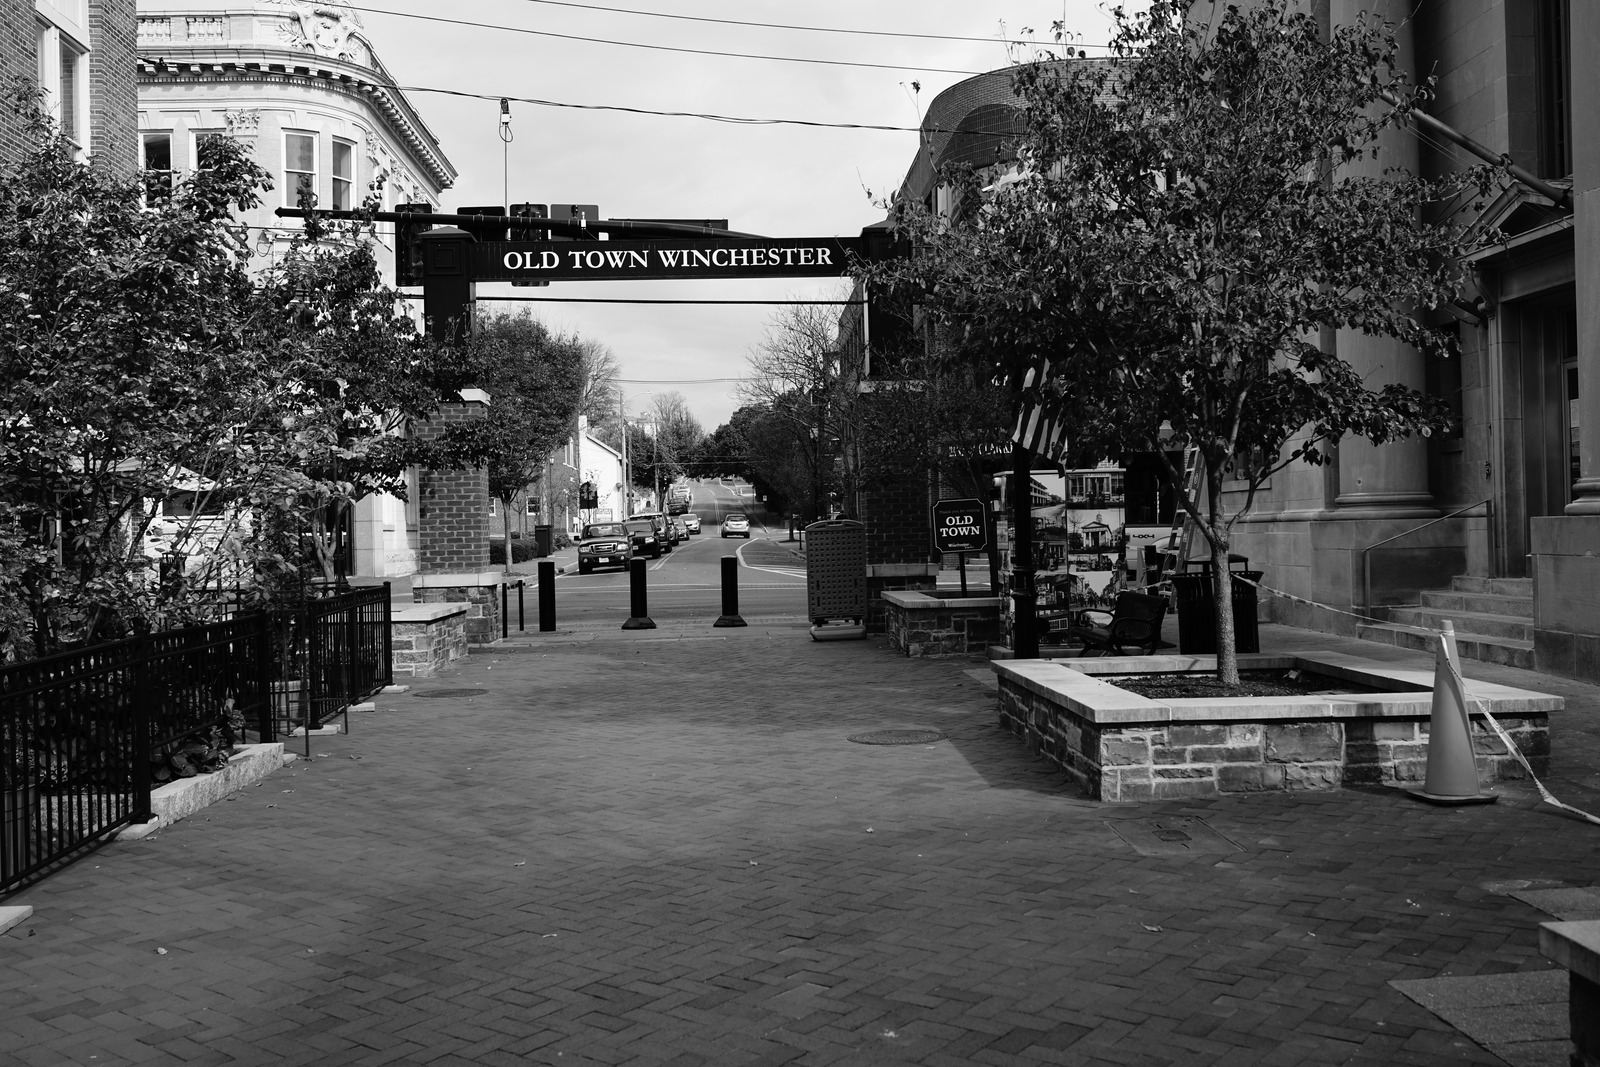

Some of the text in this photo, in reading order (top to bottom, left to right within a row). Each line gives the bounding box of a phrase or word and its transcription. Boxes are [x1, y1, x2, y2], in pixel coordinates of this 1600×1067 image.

[503, 247, 834, 271] OLD TOWN WINCHESTER
[946, 515, 973, 526] OLD
[940, 525, 980, 537] TOWN
